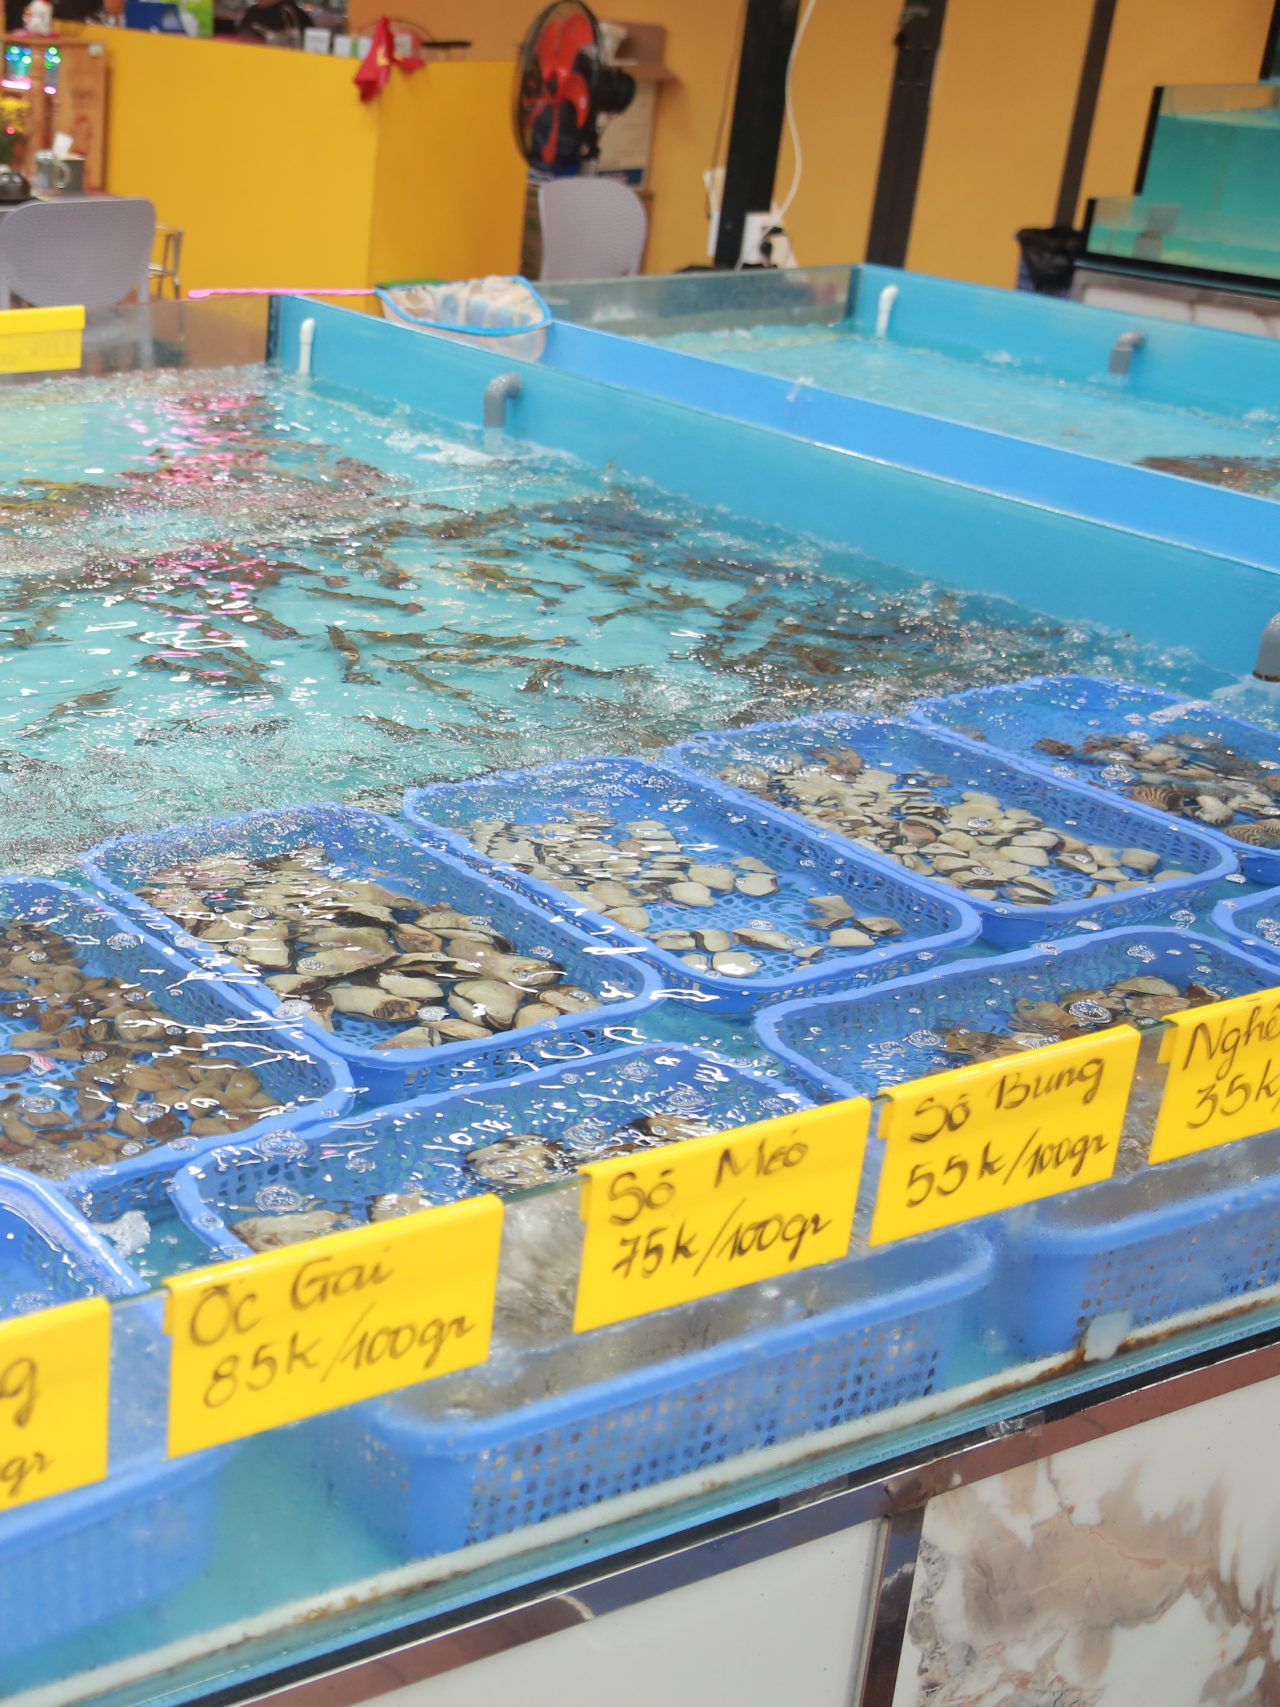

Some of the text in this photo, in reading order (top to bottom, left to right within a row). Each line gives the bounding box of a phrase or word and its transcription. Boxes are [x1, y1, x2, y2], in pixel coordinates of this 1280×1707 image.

[1186, 1058, 1280, 1130] 35k
[906, 1128, 1110, 1209] 55k/100gr
[611, 1196, 833, 1280] 75k/100gr
[290, 1246, 396, 1312] Gai
[203, 1302, 477, 1410] 85k/100gr
